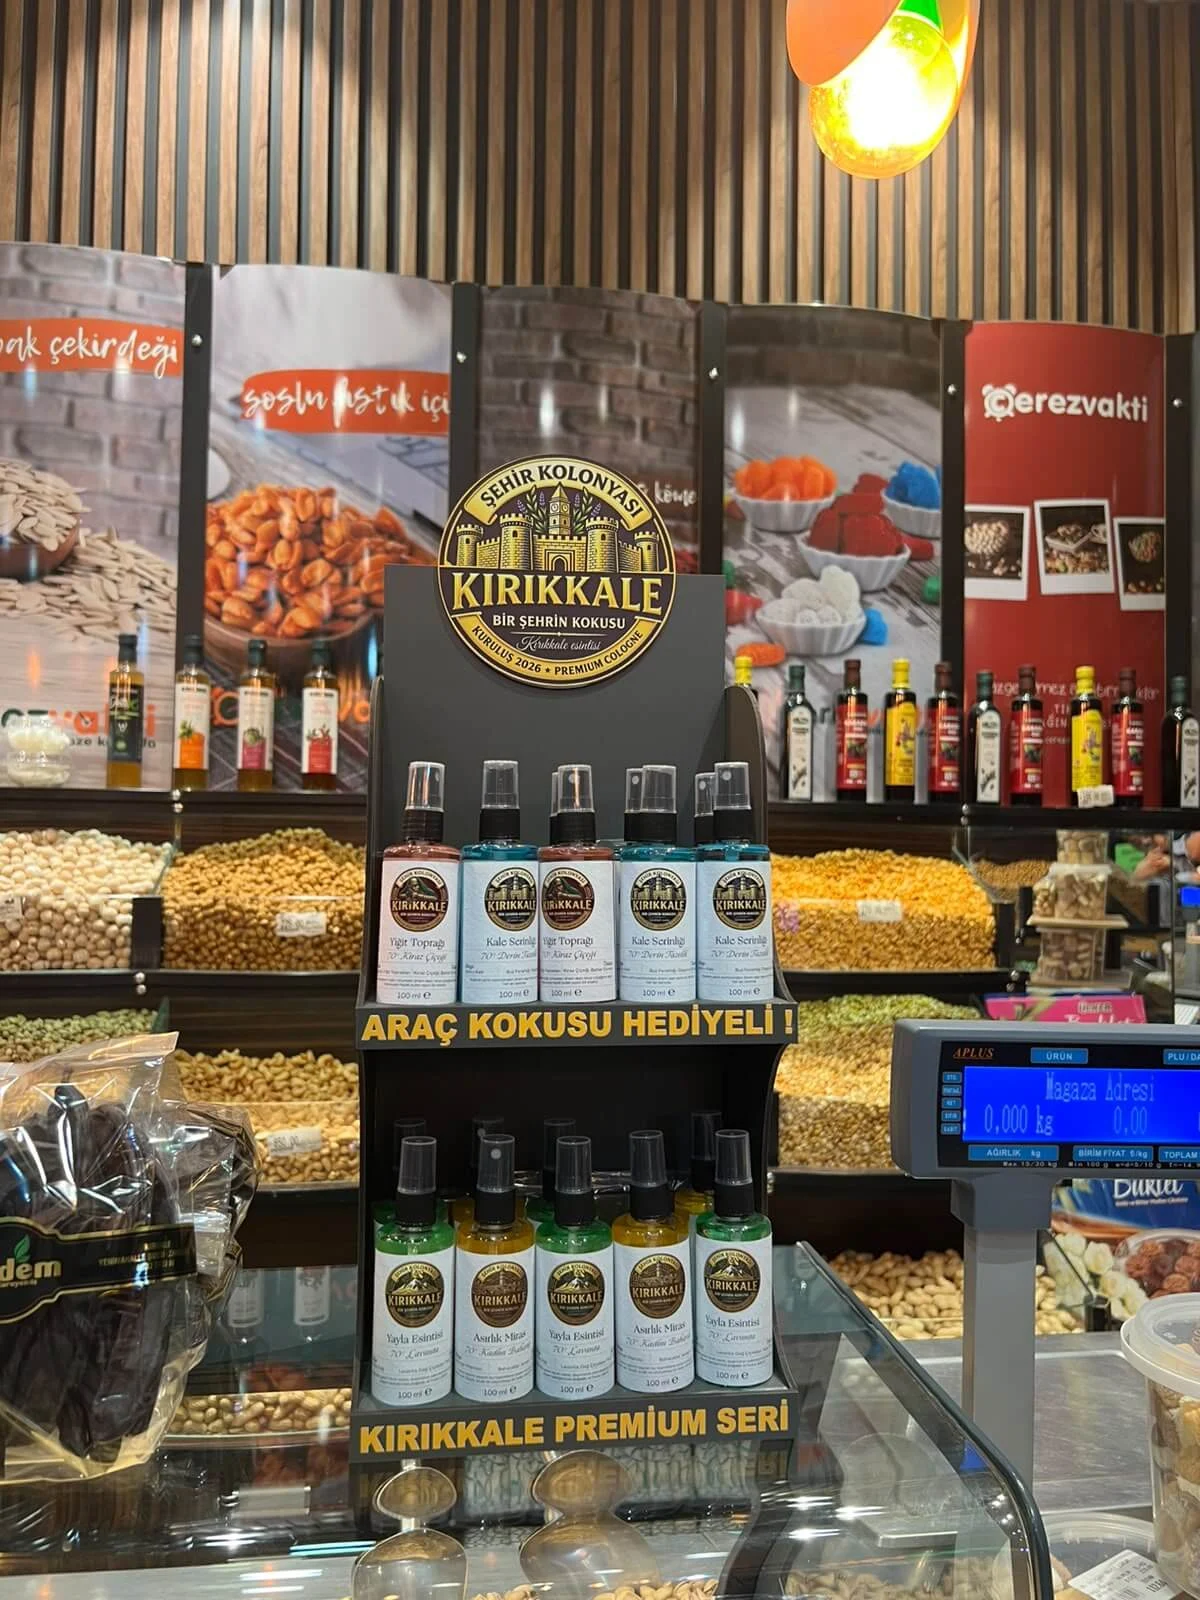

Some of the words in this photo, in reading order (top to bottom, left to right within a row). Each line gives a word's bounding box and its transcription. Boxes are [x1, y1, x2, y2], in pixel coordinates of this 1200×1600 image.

[0, 325, 42, 362] ak
[50, 326, 178, 380] çekirdeği
[480, 468, 533, 509] ŞEHİR
[538, 464, 645, 519] KOLONYASI
[452, 572, 662, 615] KIRIKKALE
[492, 612, 516, 628] BİR
[519, 612, 568, 630] ŞEHRİN
[572, 615, 626, 630] KOKUSU
[570, 638, 601, 651] esintisi
[471, 625, 514, 663] KURULUŞ
[514, 657, 542, 674] 2026
[553, 658, 604, 676] PREMIUM
[603, 630, 644, 664] COLOGNE
[632, 900, 686, 911] KIRIKKALE
[715, 900, 767, 911] KIRIKKALE
[486, 936, 507, 946] Kale
[559, 936, 594, 948] Toprağı
[631, 936, 650, 946] Kale
[715, 936, 735, 945] Kale
[397, 991, 411, 1000] 100
[499, 991, 513, 999] 100
[551, 989, 563, 997] 100
[642, 989, 656, 997] 100
[729, 988, 743, 996] 100
[360, 1012, 459, 1047] ARAÇ
[468, 1011, 612, 1040] KOKUSU
[622, 1003, 775, 1037] HEDİYELİ
[784, 1009, 794, 1035] !
[953, 1047, 995, 1059] APLUS
[1046, 1051, 1073, 1062] ÜRÜN
[1045, 1072, 1097, 1102] Magaza
[1105, 1072, 1155, 1102] Adresi
[1036, 1104, 1054, 1136] kg
[986, 1148, 1021, 1158] AĞIRLIK
[1031, 1150, 1041, 1159] kg
[1078, 1148, 1101, 1158] BİRİM
[1103, 1148, 1125, 1158] FİYAT
[1164, 1151, 1198, 1160] TOPLAM
[706, 1278, 758, 1292] KIRIKKALE
[387, 1292, 442, 1307] KIRIKKALE
[550, 1291, 604, 1304] KIRIKKALE
[728, 1316, 760, 1328] Esintisi
[548, 1329, 571, 1342] Yayla
[573, 1328, 605, 1341] Esintisi
[633, 1324, 662, 1335] Asırlık
[386, 1332, 409, 1346] Yayla
[411, 1329, 444, 1344] Esintisi
[473, 1333, 502, 1344] Asırlık
[716, 1371, 729, 1380] 100
[646, 1379, 660, 1387] 100
[398, 1390, 412, 1399] 100
[483, 1388, 497, 1397] 100
[560, 1385, 574, 1393] 100
[359, 1416, 545, 1454] KIRIKKALE
[554, 1405, 706, 1443] PREMİUM
[716, 1398, 789, 1434] SERİ
